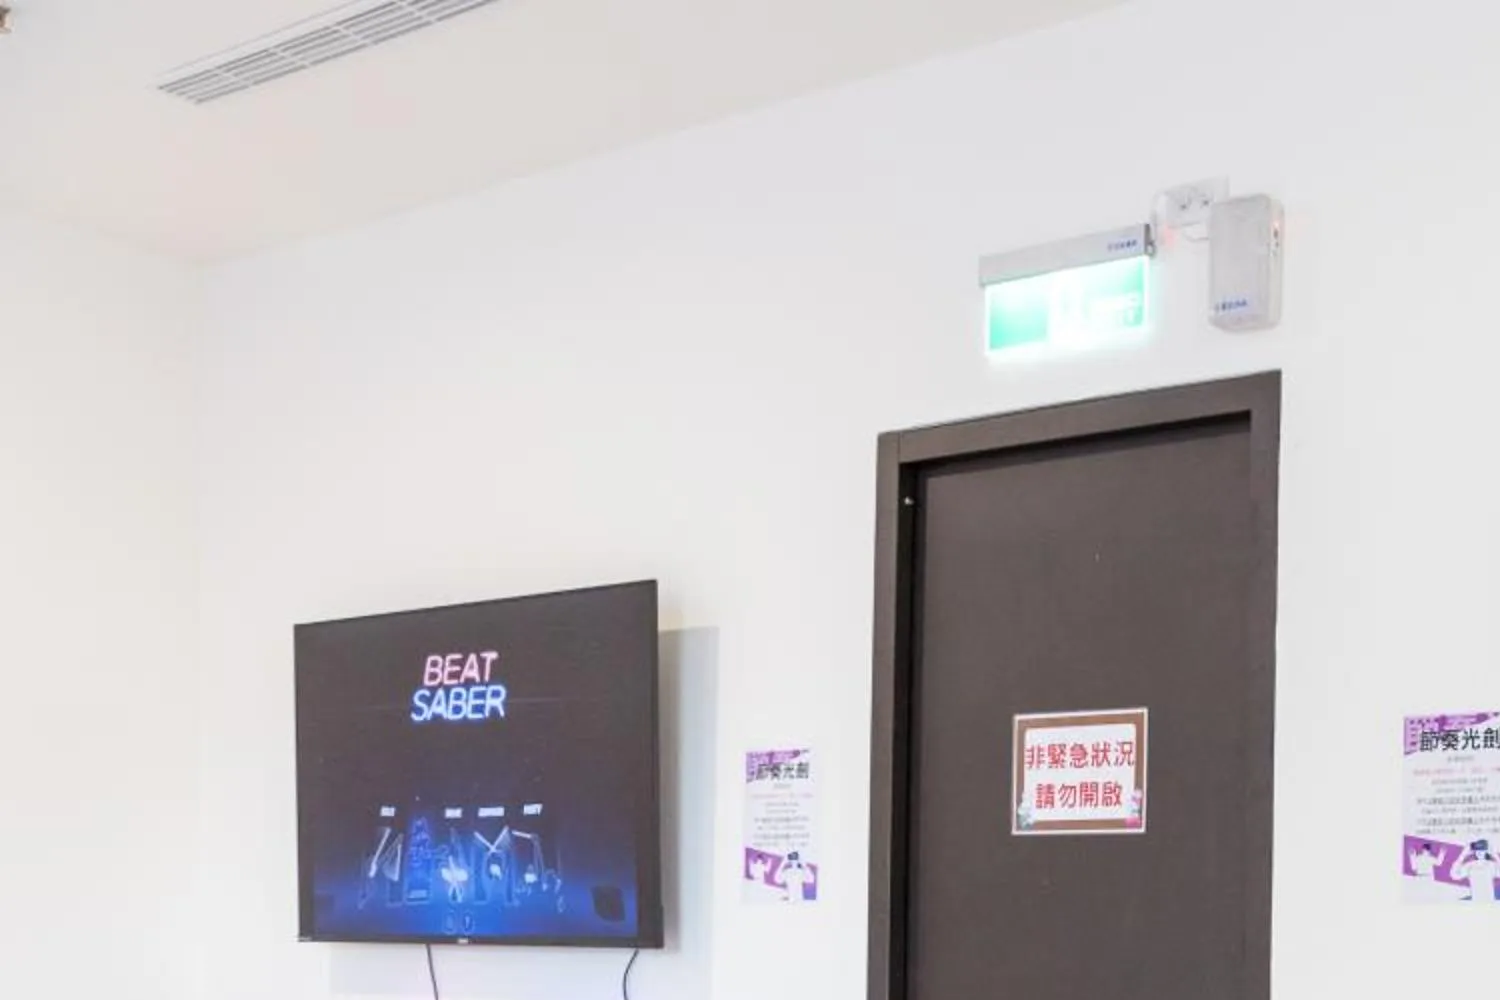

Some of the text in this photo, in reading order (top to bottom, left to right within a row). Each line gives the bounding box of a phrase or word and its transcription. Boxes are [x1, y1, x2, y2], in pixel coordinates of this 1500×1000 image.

[423, 651, 499, 686] BEAT
[411, 684, 507, 721] SABER
[1025, 741, 1135, 769] 非緊急狀況
[1035, 781, 1123, 809] 請勿開啟
